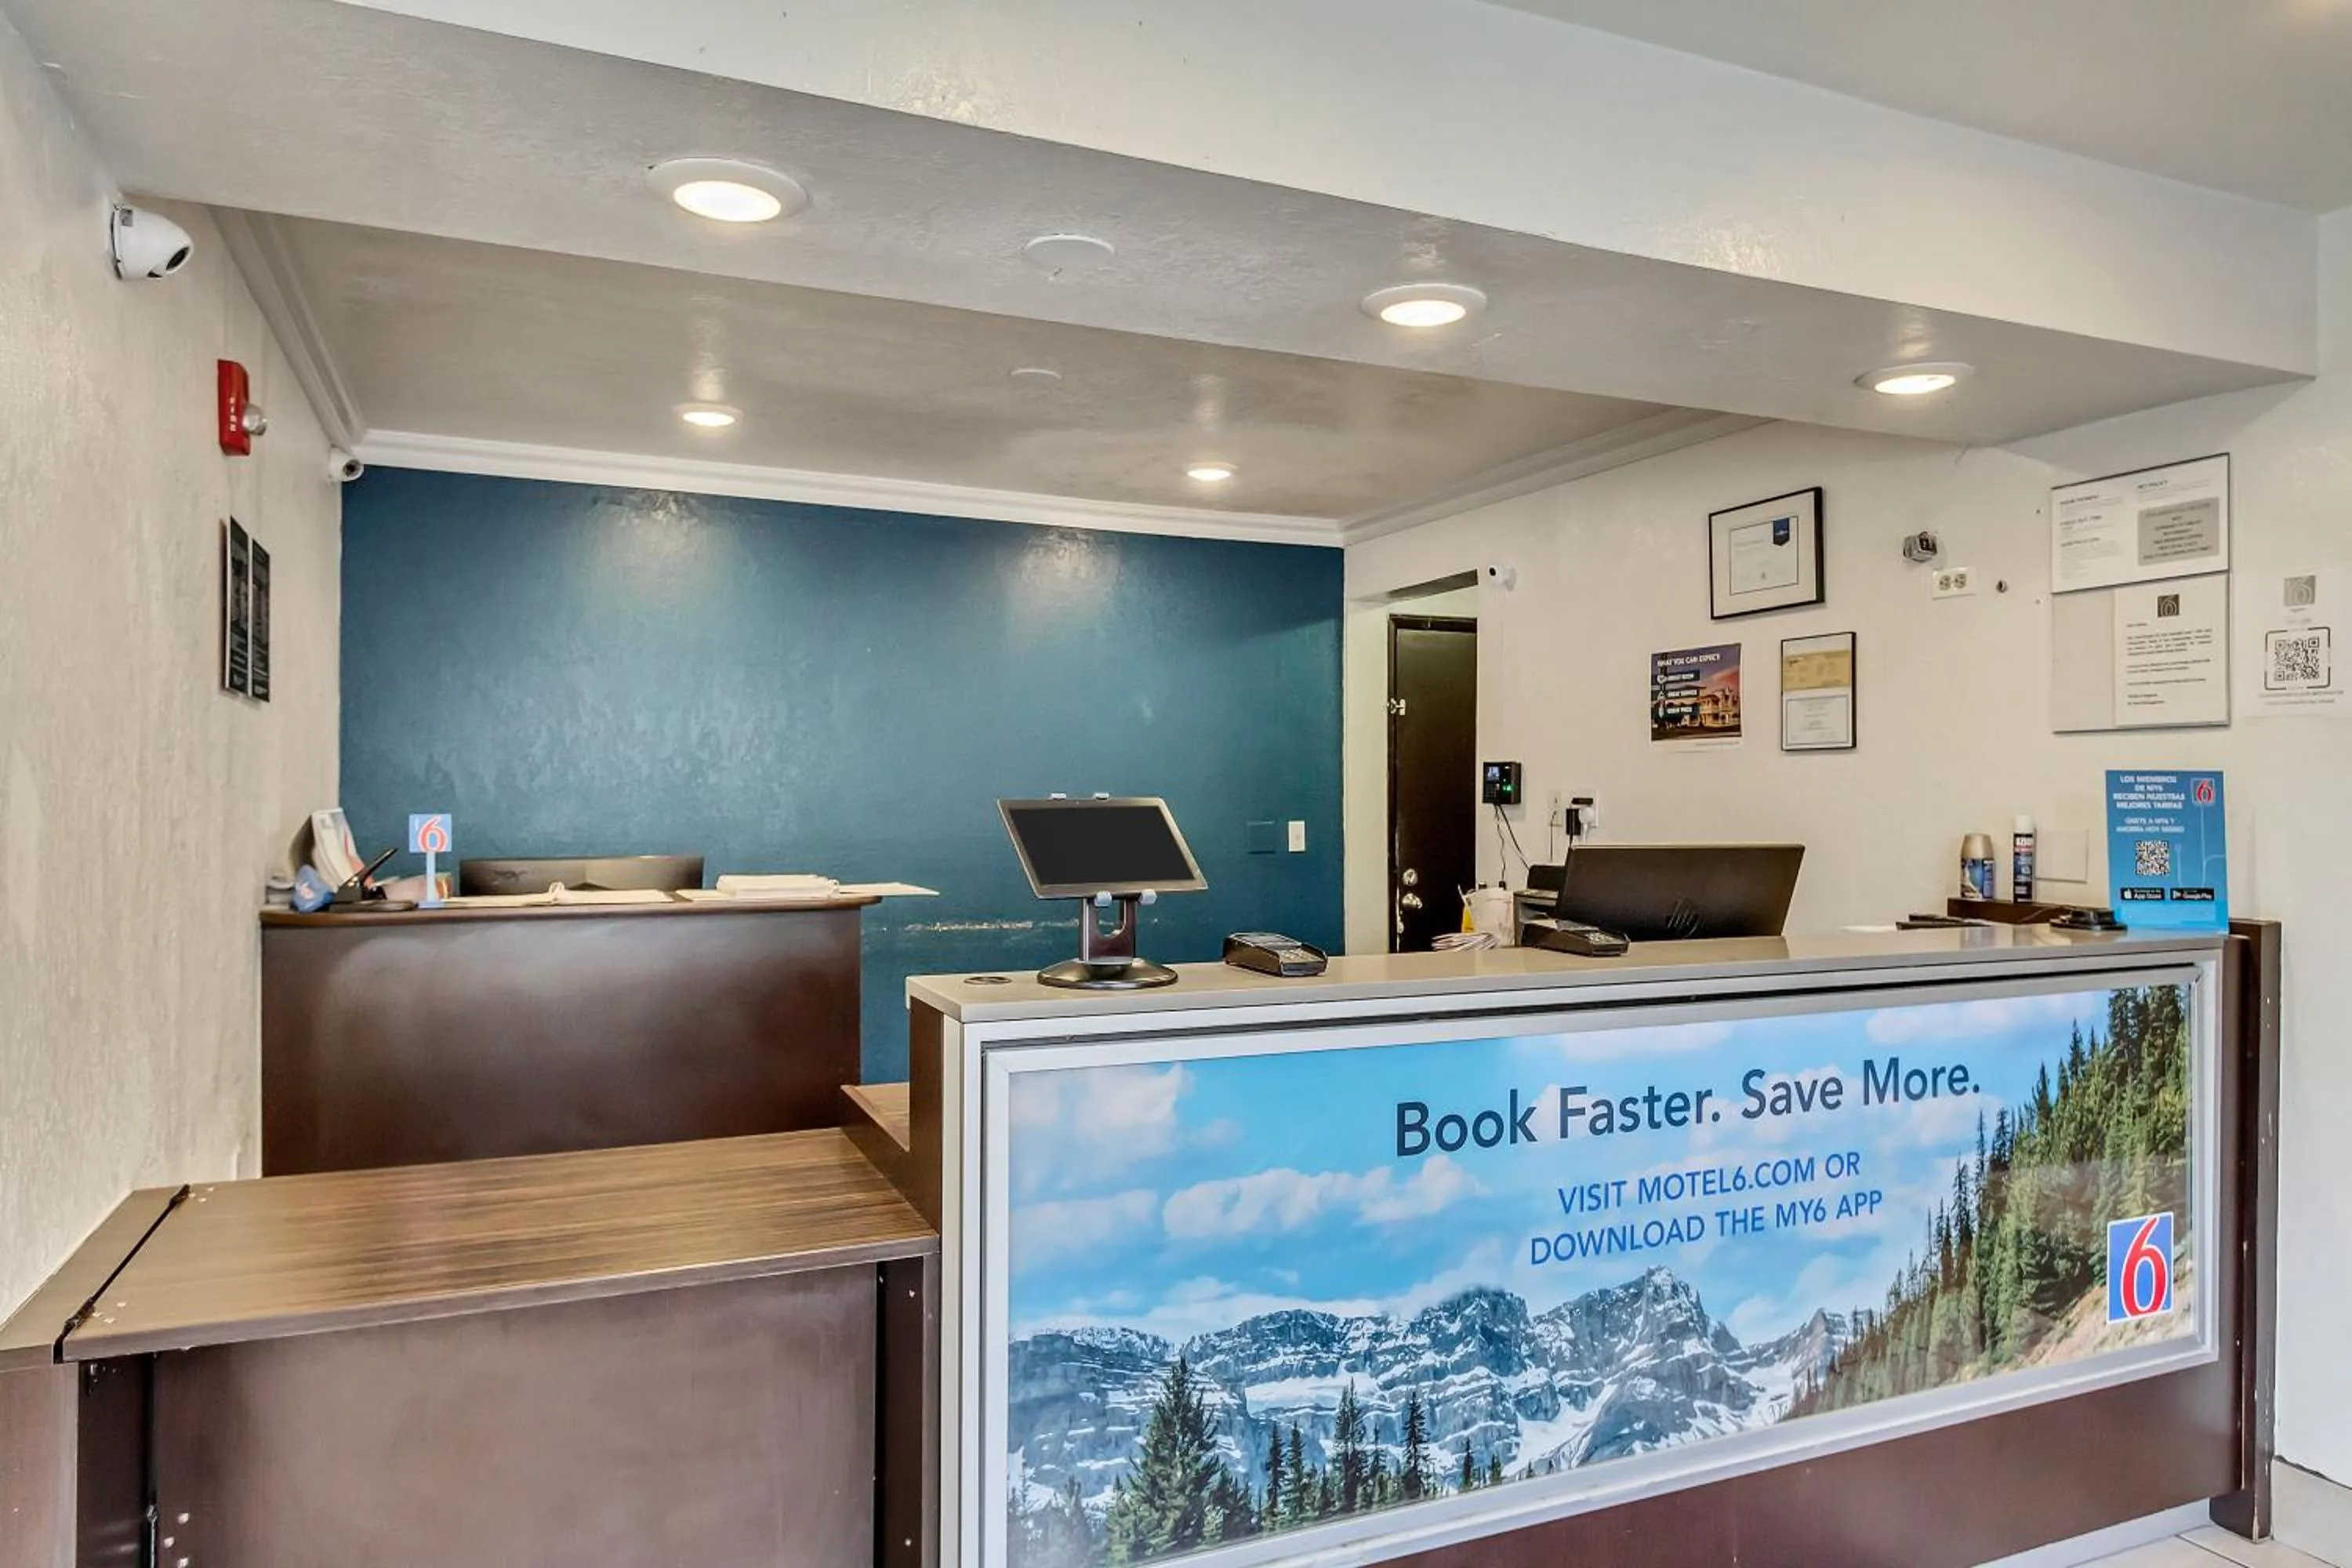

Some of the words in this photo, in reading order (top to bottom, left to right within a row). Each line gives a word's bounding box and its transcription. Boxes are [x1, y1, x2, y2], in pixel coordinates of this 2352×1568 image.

[417, 815, 448, 851] 6
[1396, 1088, 1537, 1157] Book
[1559, 1085, 1721, 1139] Faster.
[1741, 1069, 1842, 1119] Save
[1863, 1057, 1980, 1105] More.
[1558, 1181, 1627, 1214] VISIT
[1638, 1156, 1815, 1205] MOTEL6.COM
[1824, 1152, 1861, 1178] OR
[1530, 1215, 1704, 1265] DOWNLOAD
[1715, 1206, 1766, 1236] THE
[1775, 1197, 1827, 1229] MY6
[1835, 1190, 1882, 1220] APP
[2121, 1215, 2169, 1317] 6
